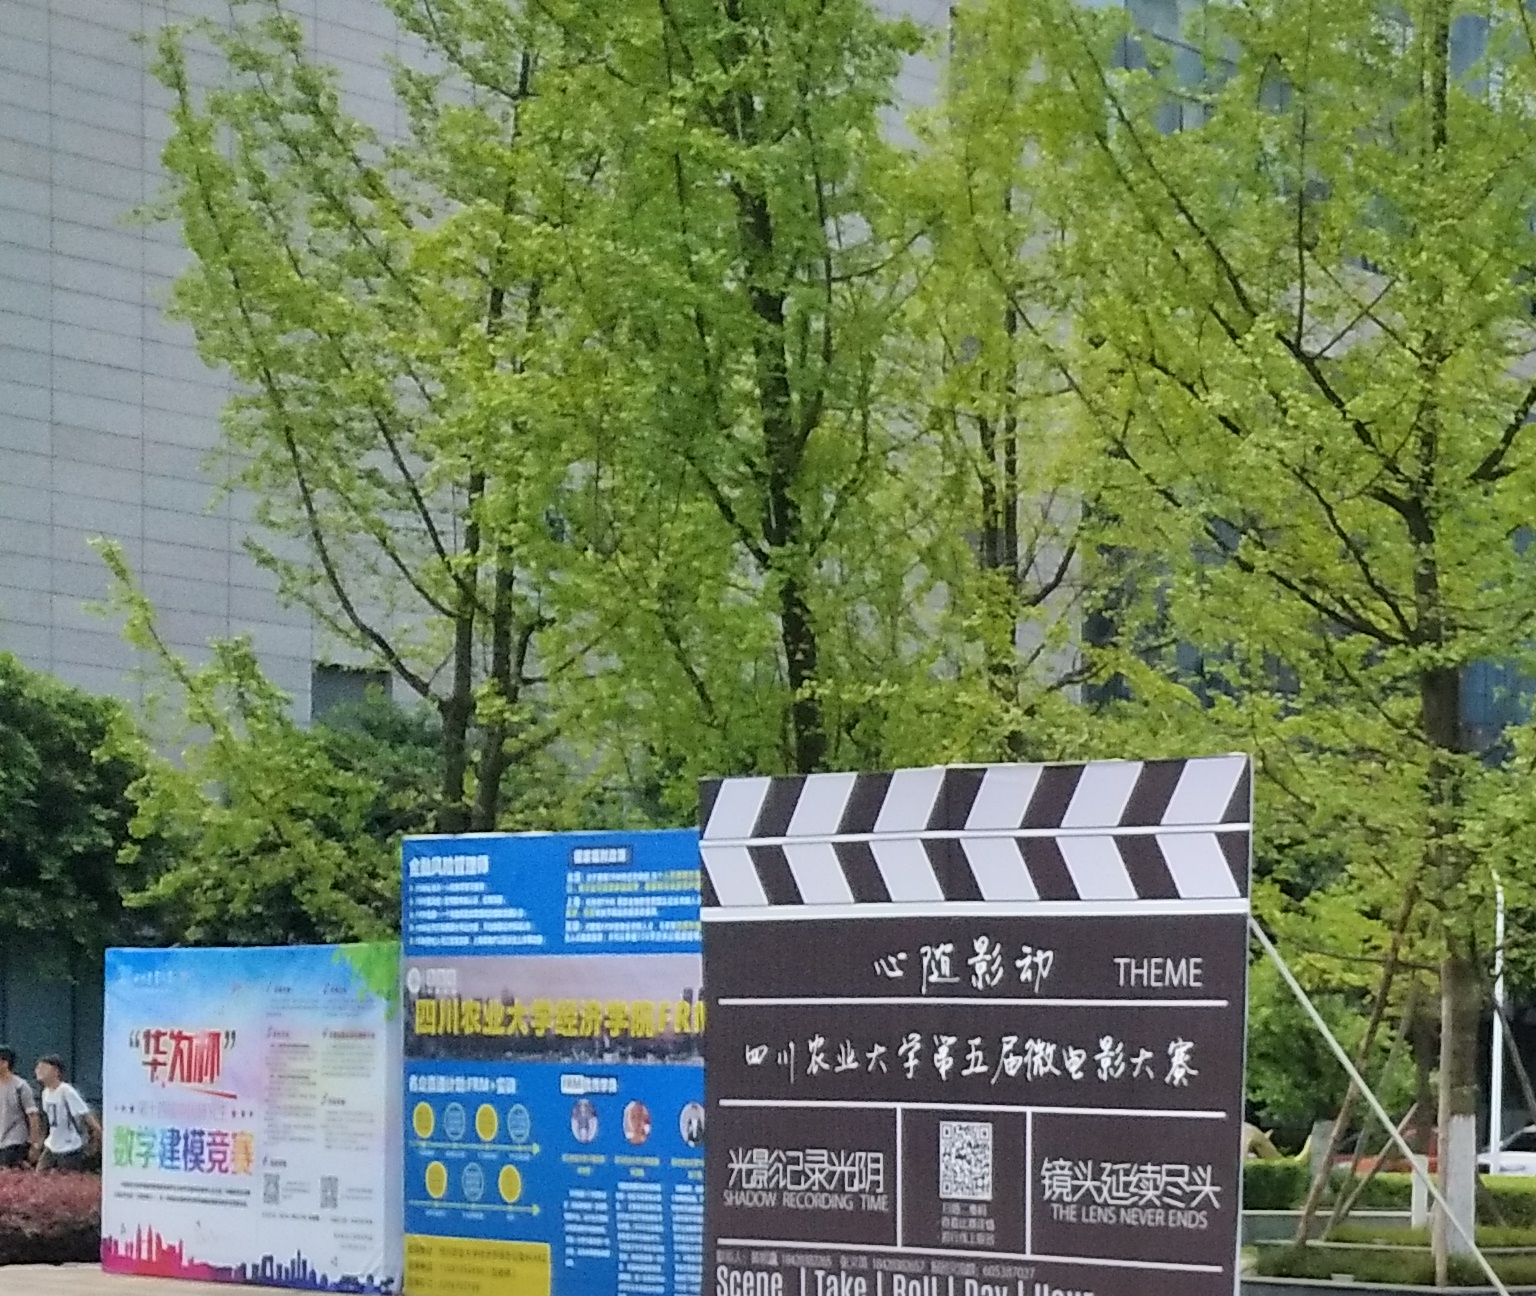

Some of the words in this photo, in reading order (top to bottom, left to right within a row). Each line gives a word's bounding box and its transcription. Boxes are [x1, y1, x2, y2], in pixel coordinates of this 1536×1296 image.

[873, 936, 1054, 994] 心随影动
[1114, 957, 1203, 988] THEME
[745, 1033, 1199, 1087] 四川农业大学第五届微电影大赛
[114, 1126, 254, 1175] 数学建模竞赛
[727, 1148, 883, 1194] 光影记录光阴
[723, 1190, 777, 1207] SHADOW
[782, 1191, 854, 1211] RECORDING
[861, 1194, 889, 1212] TIME
[1040, 1157, 1221, 1209] 镜头延续尽头
[1051, 1203, 1077, 1222] THE
[1081, 1205, 1115, 1225] LENS
[1120, 1207, 1169, 1228] NEVER
[1170, 1209, 1207, 1229] ENDS
